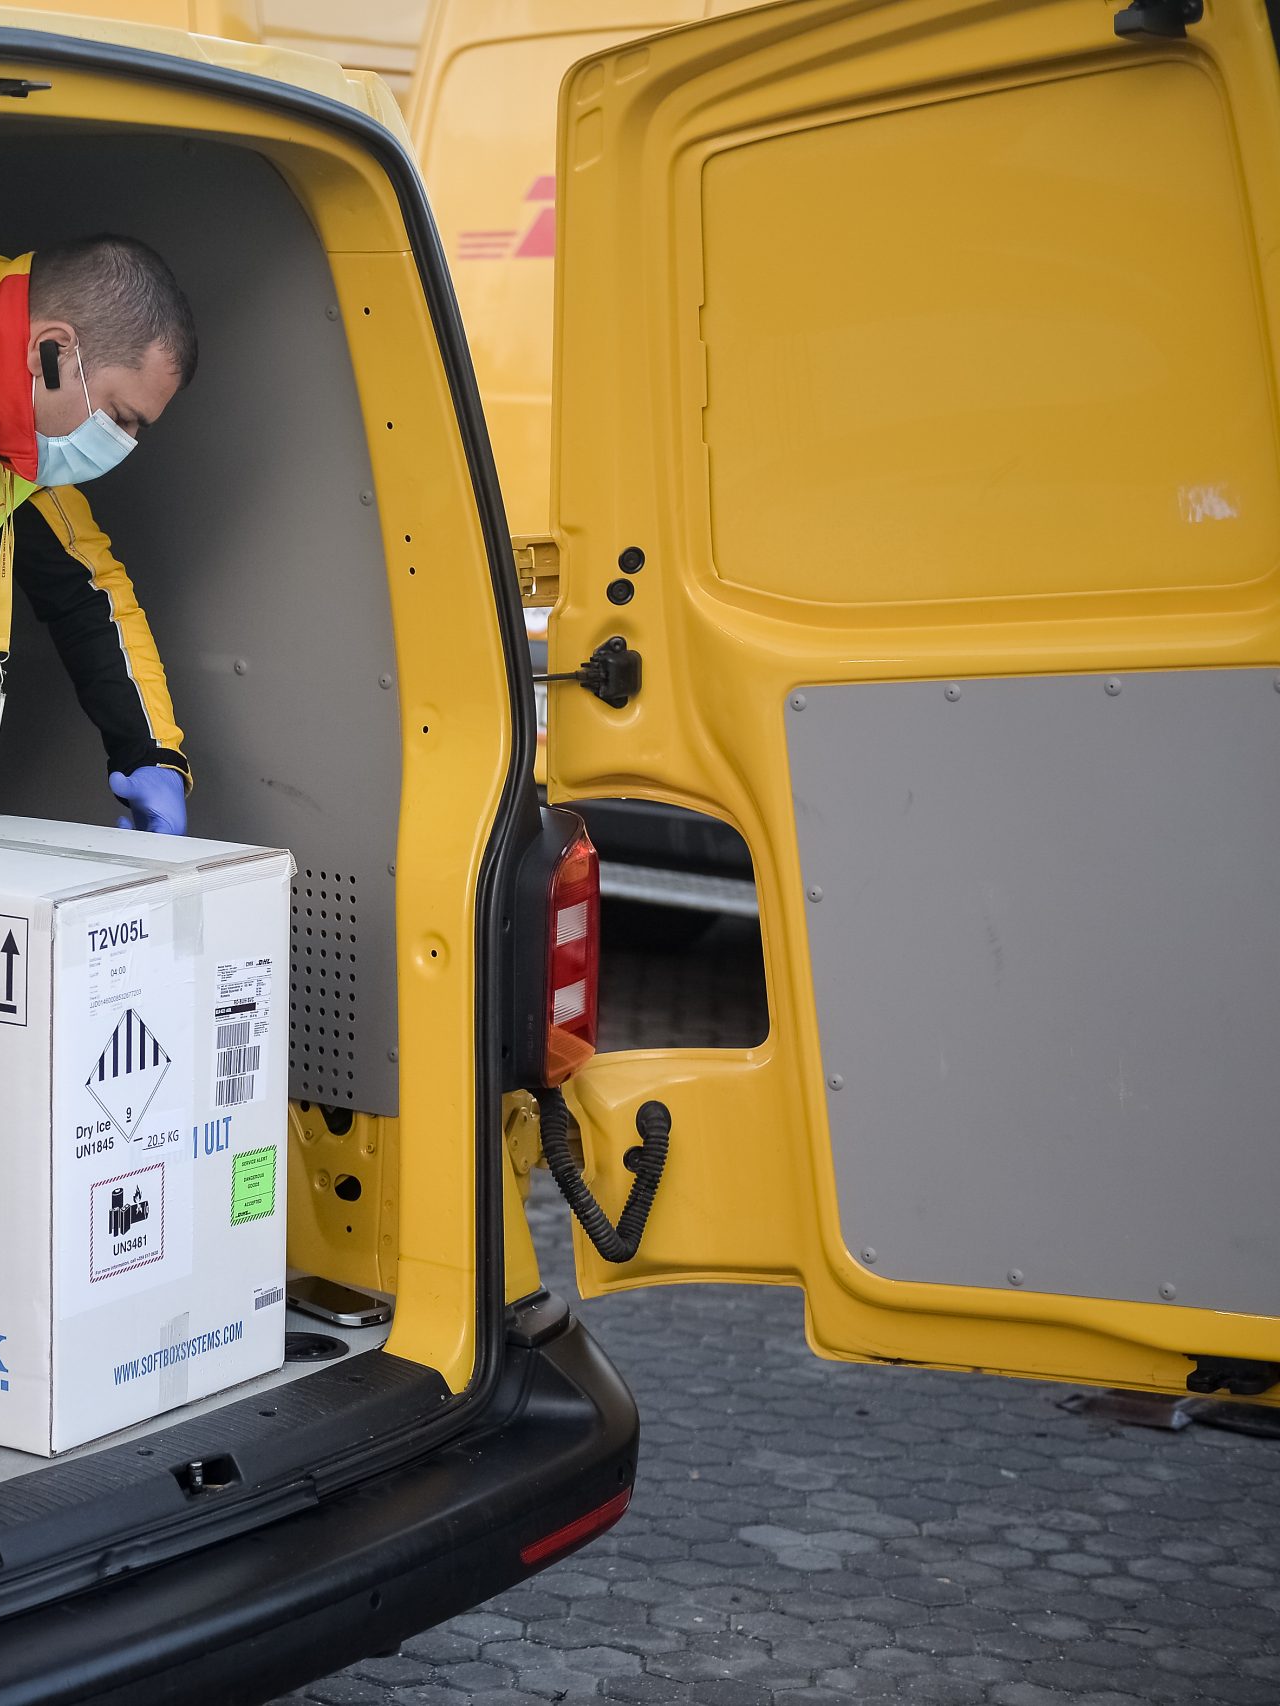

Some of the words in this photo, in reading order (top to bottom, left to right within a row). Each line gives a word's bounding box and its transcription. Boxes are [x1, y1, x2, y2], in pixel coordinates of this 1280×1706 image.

[88, 918, 149, 952] T2V05L
[126, 1106, 132, 1119] 9
[76, 1125, 94, 1140] Dry
[96, 1120, 111, 1134] Ice
[147, 1132, 165, 1147] 20.5
[167, 1129, 180, 1143] KG
[205, 1115, 232, 1155] ULT
[76, 1136, 115, 1159] UN1845
[241, 1158, 256, 1167] SERVICE
[256, 1155, 268, 1163] ALERT
[113, 1234, 147, 1256] UN3481
[113, 1320, 243, 1386] WWW.SOFTBOXSYSTEMS.COM
